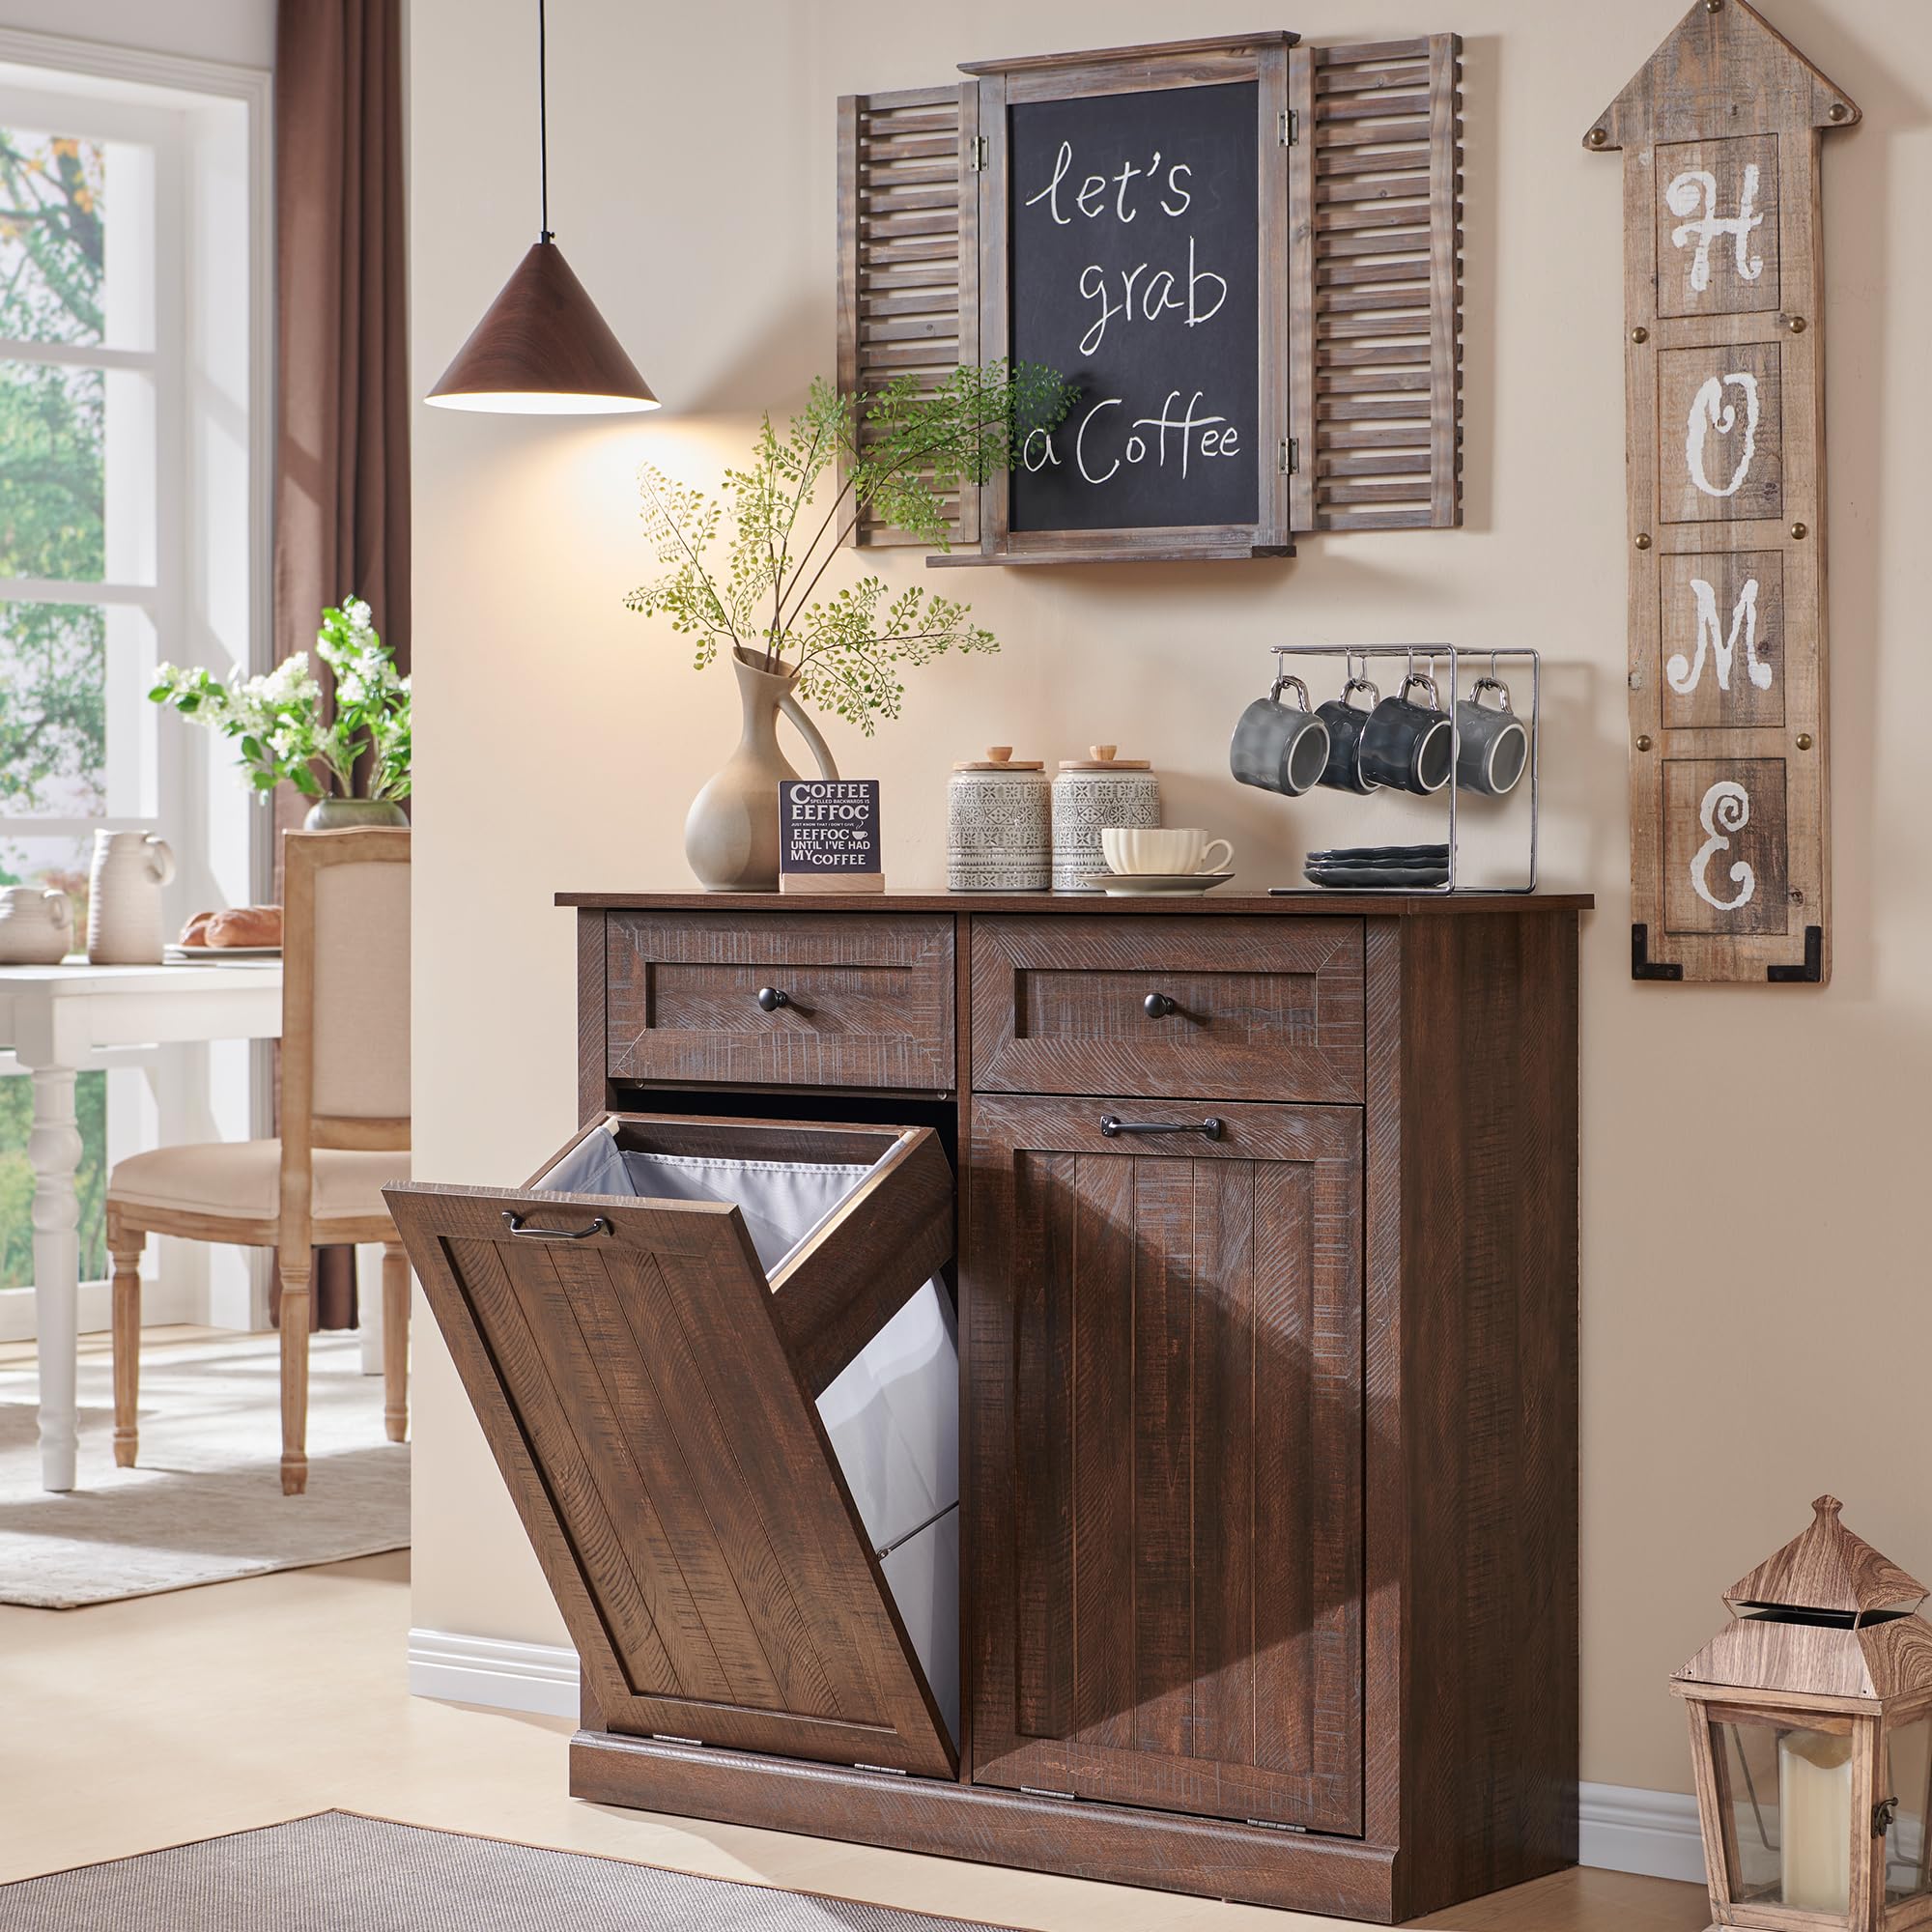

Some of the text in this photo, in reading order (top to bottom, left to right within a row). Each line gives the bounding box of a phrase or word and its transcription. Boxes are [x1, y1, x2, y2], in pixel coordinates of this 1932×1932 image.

[1026, 140, 1192, 225] let's
[1079, 236, 1227, 356] grab
[1024, 391, 1240, 484] a Coffee
[790, 783, 869, 805] COFFEE
[792, 805, 869, 820] EEFFOC
[793, 829, 850, 840] EEFFOC
[791, 840, 870, 850] UNTIL I'VE HAD
[791, 850, 867, 866] MY COFFEE
